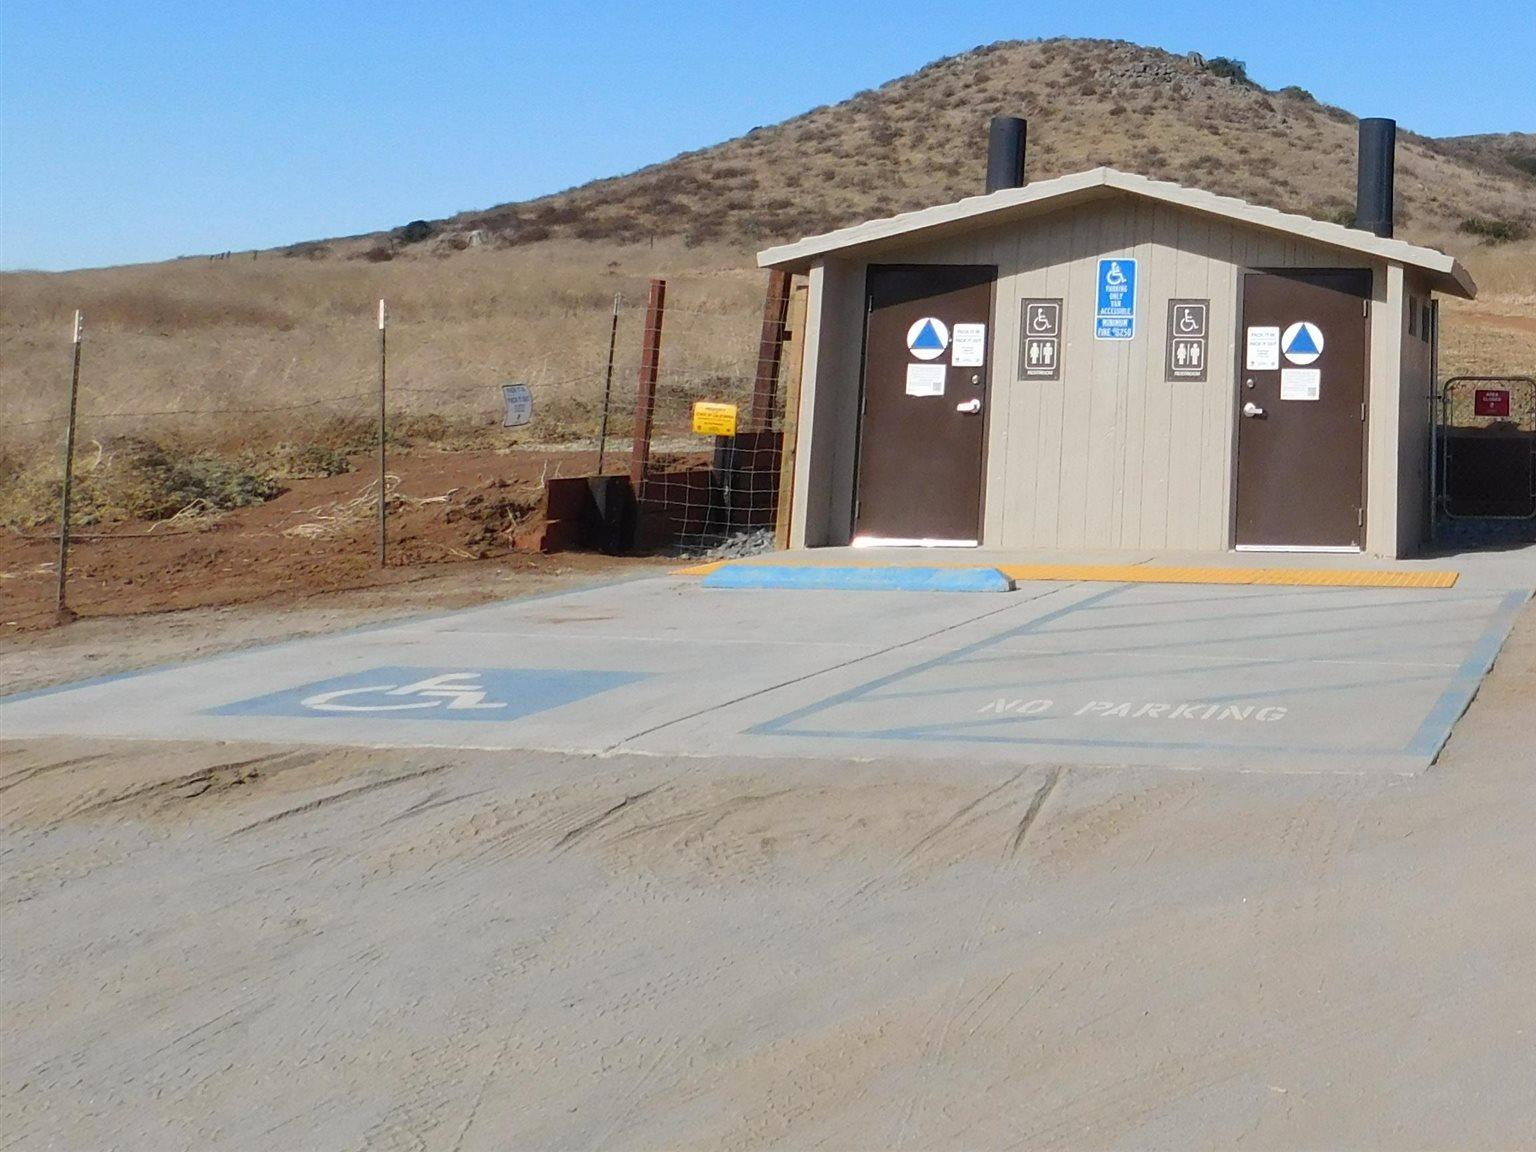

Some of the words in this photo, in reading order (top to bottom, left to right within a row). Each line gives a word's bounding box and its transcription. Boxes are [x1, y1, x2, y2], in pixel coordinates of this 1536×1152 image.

[1105, 285, 1128, 293] PARKING
[1109, 292, 1124, 300] ONLY
[1110, 300, 1122, 308] VAN
[1102, 318, 1128, 327] MINIMUM
[1098, 328, 1111, 337] FINE
[1111, 328, 1132, 337] $250
[977, 698, 1054, 714] NO
[1073, 699, 1288, 722] PARKING
